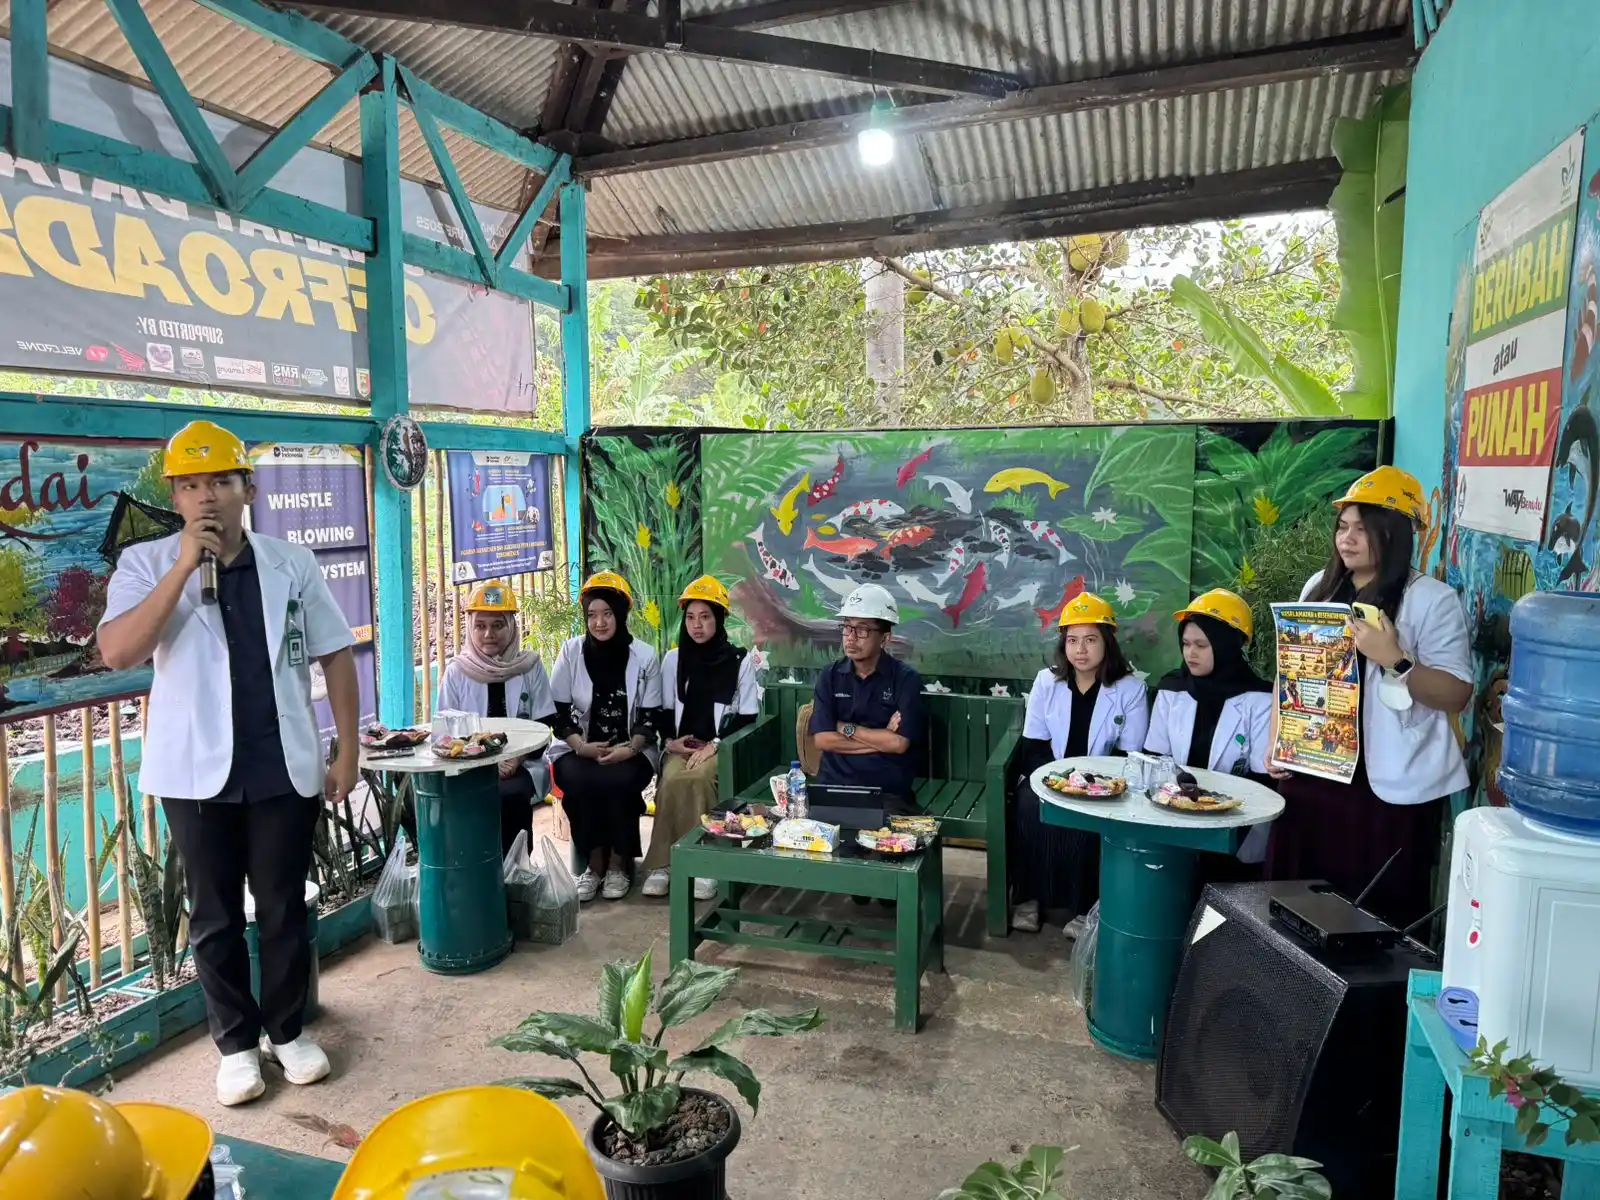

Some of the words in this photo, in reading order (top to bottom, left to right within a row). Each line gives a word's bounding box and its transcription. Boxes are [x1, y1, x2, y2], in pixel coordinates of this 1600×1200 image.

[1472, 218, 1568, 334] BERUBAH
[1492, 336, 1519, 376] atau
[1465, 380, 1548, 458] PUNAH
[0, 438, 121, 513] dai
[267, 491, 333, 510] WHISTLE
[287, 525, 355, 545] BLOWING
[319, 560, 366, 580] YSTEM
